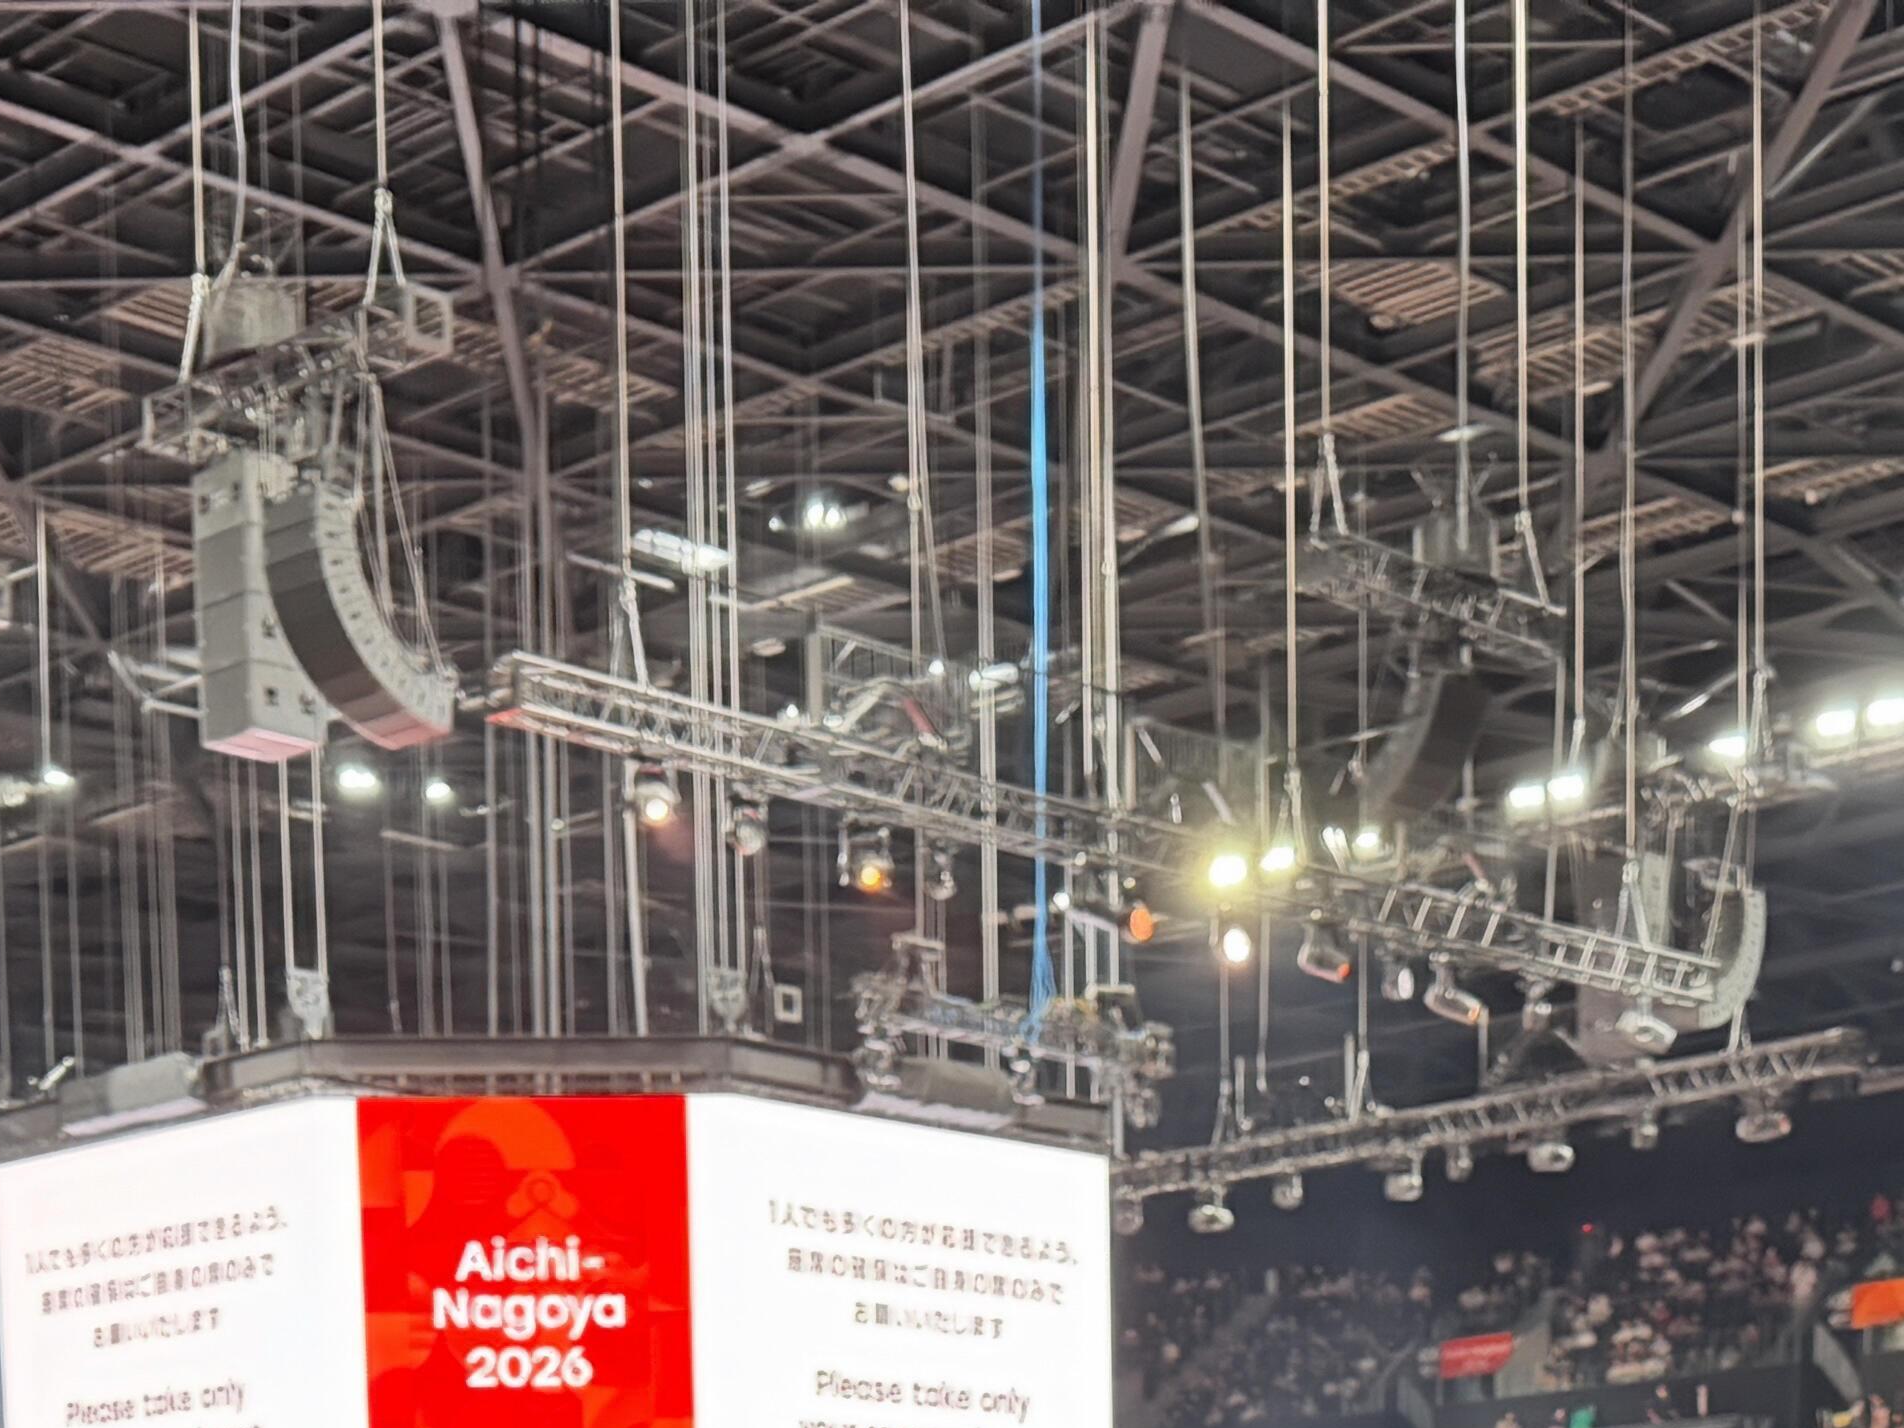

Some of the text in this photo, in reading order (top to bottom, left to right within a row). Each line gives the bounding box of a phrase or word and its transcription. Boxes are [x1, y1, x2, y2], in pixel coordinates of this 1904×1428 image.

[454, 1235, 606, 1282] Aichi-
[432, 1286, 627, 1341] Nagoya
[465, 1345, 594, 1389] 2026
[66, 1399, 136, 1427] Please
[815, 1369, 1031, 1424] Please take only
